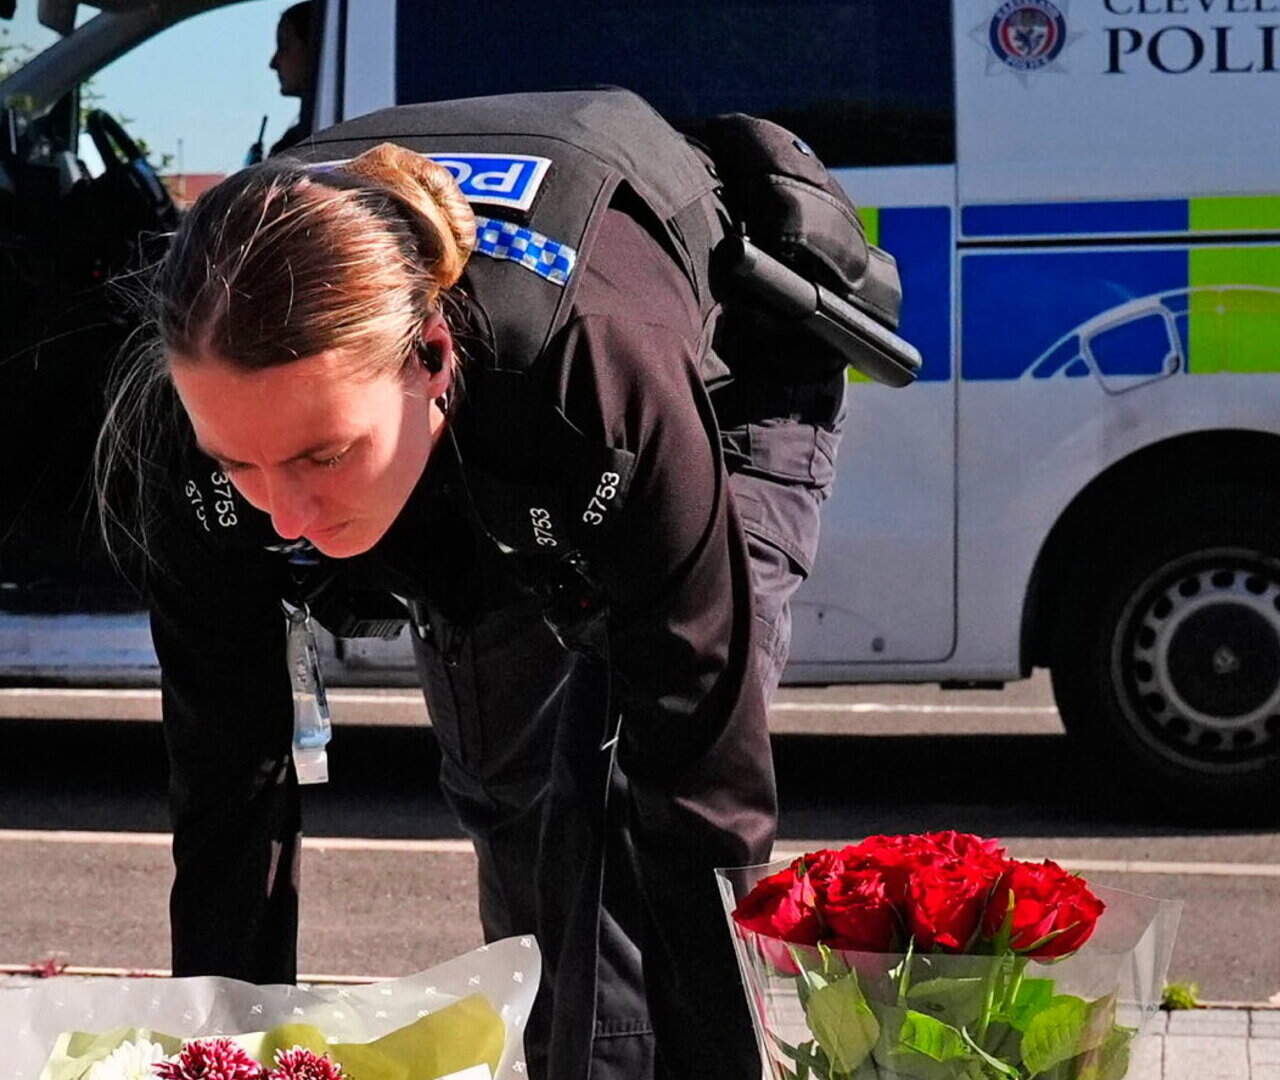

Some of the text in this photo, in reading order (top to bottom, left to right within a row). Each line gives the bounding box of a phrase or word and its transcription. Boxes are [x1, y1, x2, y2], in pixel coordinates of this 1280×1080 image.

[210, 471, 238, 527] 3753
[582, 471, 620, 526] 3753
[529, 507, 558, 547] 3753
